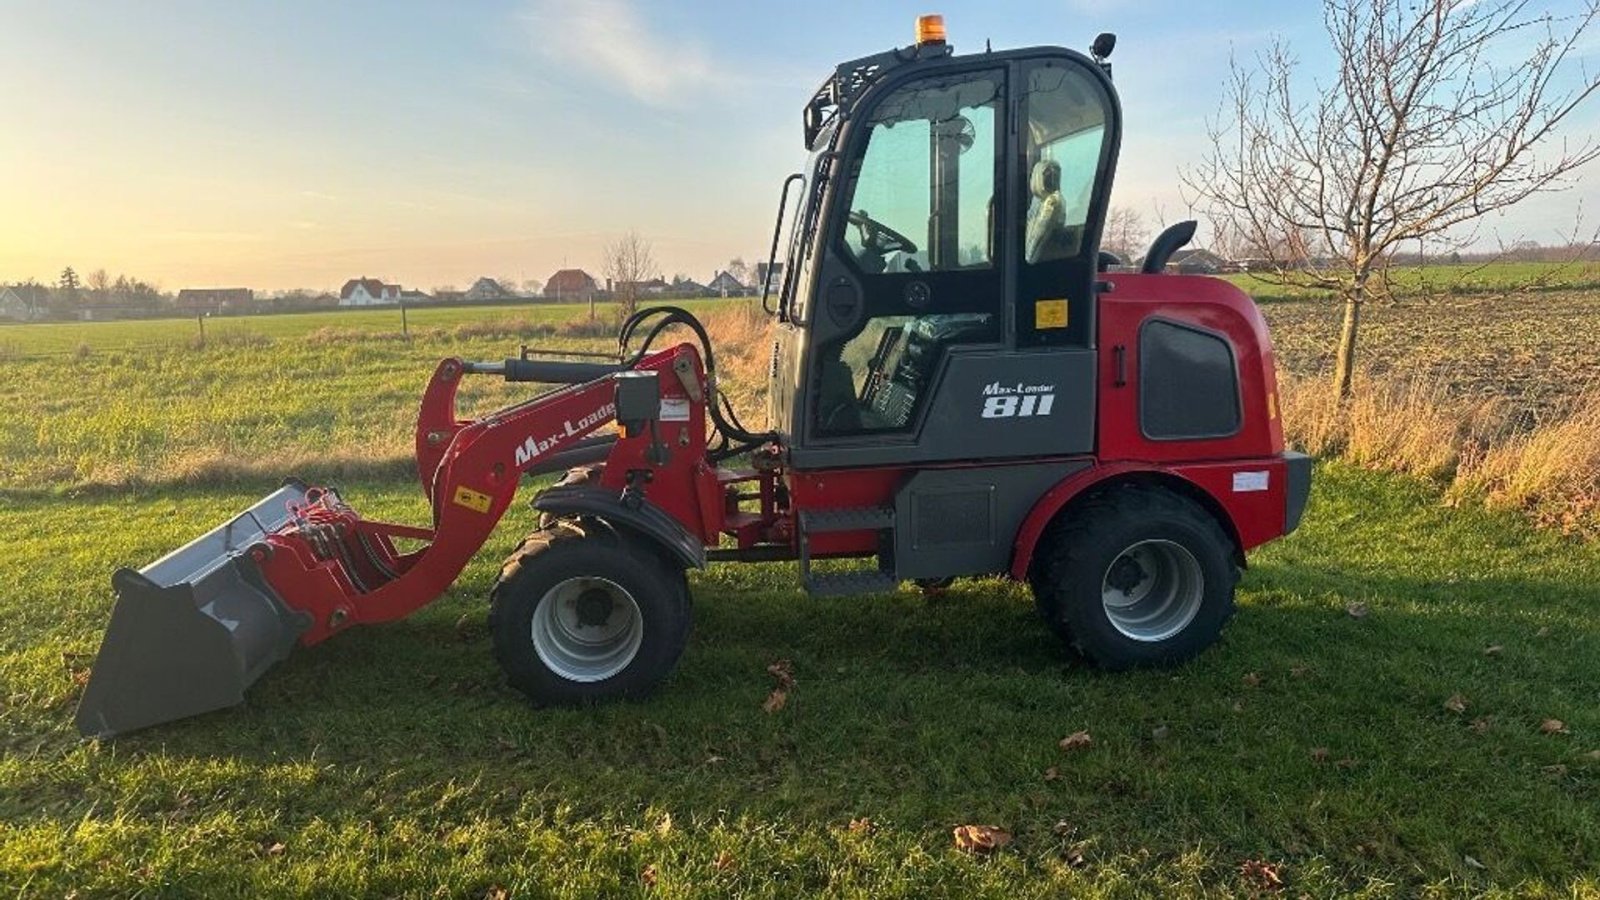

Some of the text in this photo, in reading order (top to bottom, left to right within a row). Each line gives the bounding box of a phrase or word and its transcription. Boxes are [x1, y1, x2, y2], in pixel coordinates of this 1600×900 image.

[983, 381, 1054, 395] Max-Loader
[981, 395, 1055, 418] 811
[515, 402, 617, 466] Max-Loade
